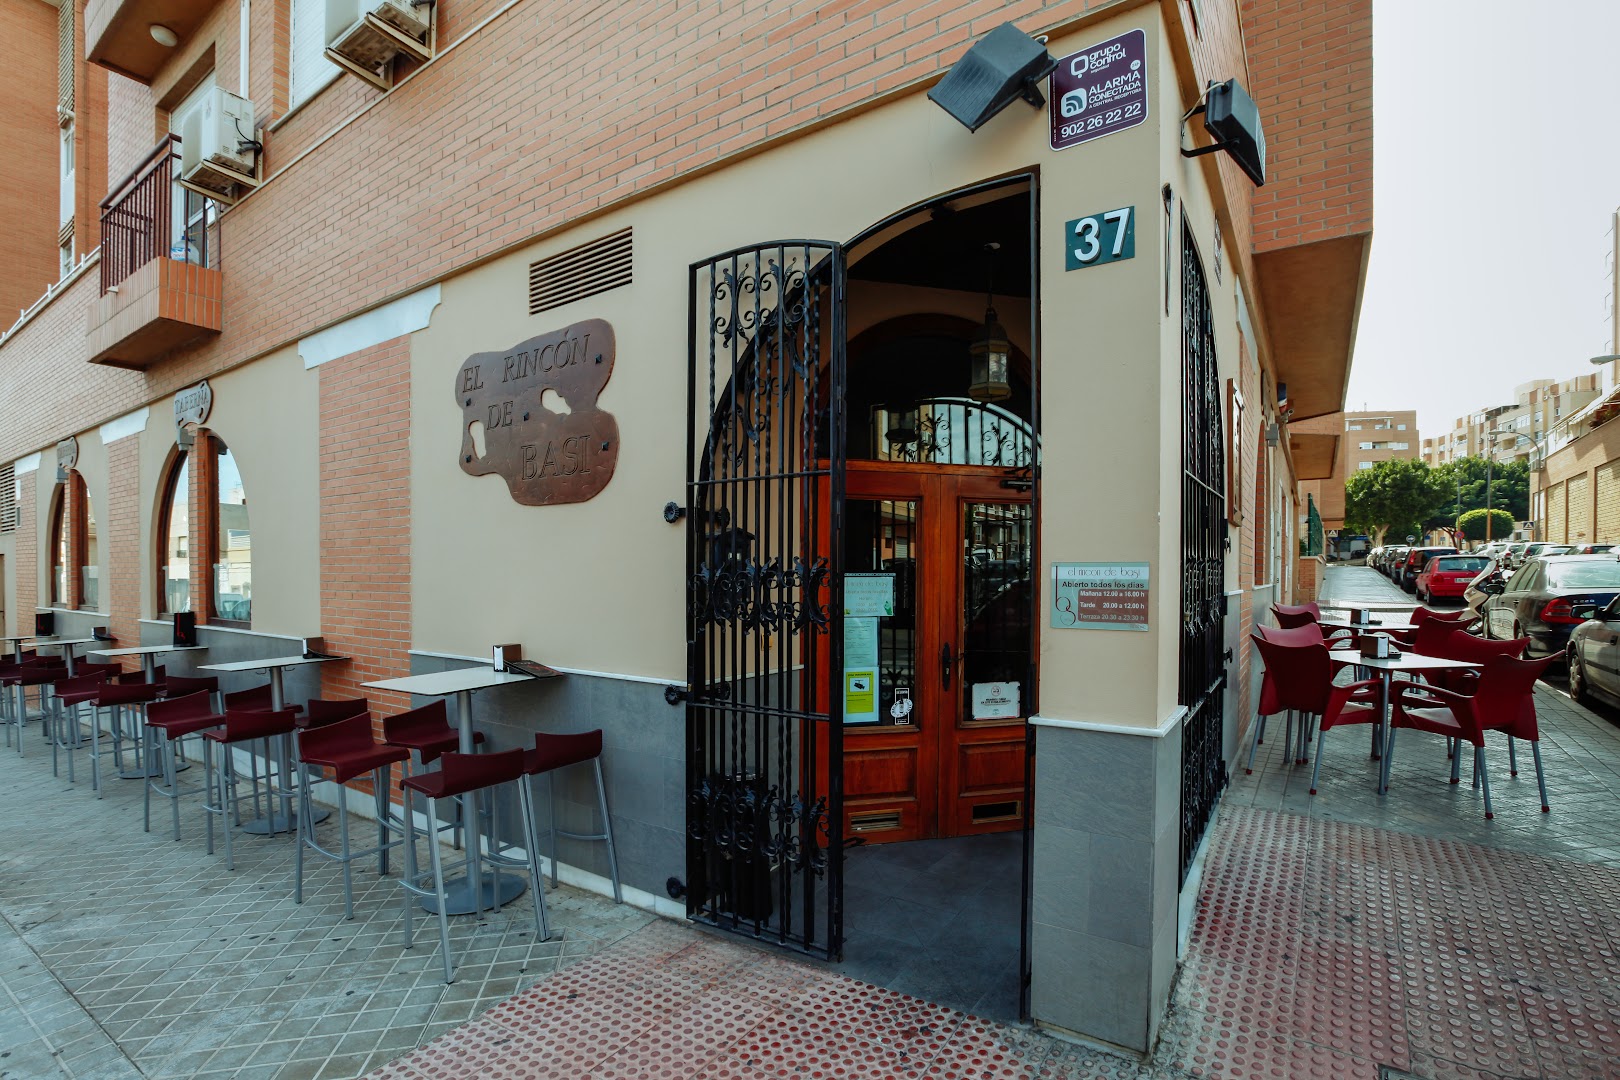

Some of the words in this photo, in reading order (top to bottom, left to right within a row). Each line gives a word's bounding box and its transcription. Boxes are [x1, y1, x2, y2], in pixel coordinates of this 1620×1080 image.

[1089, 43, 1121, 63] grupo
[1089, 48, 1127, 70] control
[1088, 70, 1141, 97] ALARMA
[1088, 80, 1141, 104] CONECTADA
[1093, 98, 1114, 108] CENTRAL
[1113, 88, 1142, 100] RECEPTORA
[1061, 121, 1085, 138] 902
[1086, 115, 1103, 131] 26
[1105, 109, 1122, 124] 22
[1124, 103, 1142, 118] 22
[1074, 207, 1131, 264] 37
[462, 365, 484, 393] EL
[502, 329, 591, 383] RINCÓN
[486, 400, 514, 431] DE
[520, 434, 591, 481] BASI
[1104, 567, 1117, 576] de
